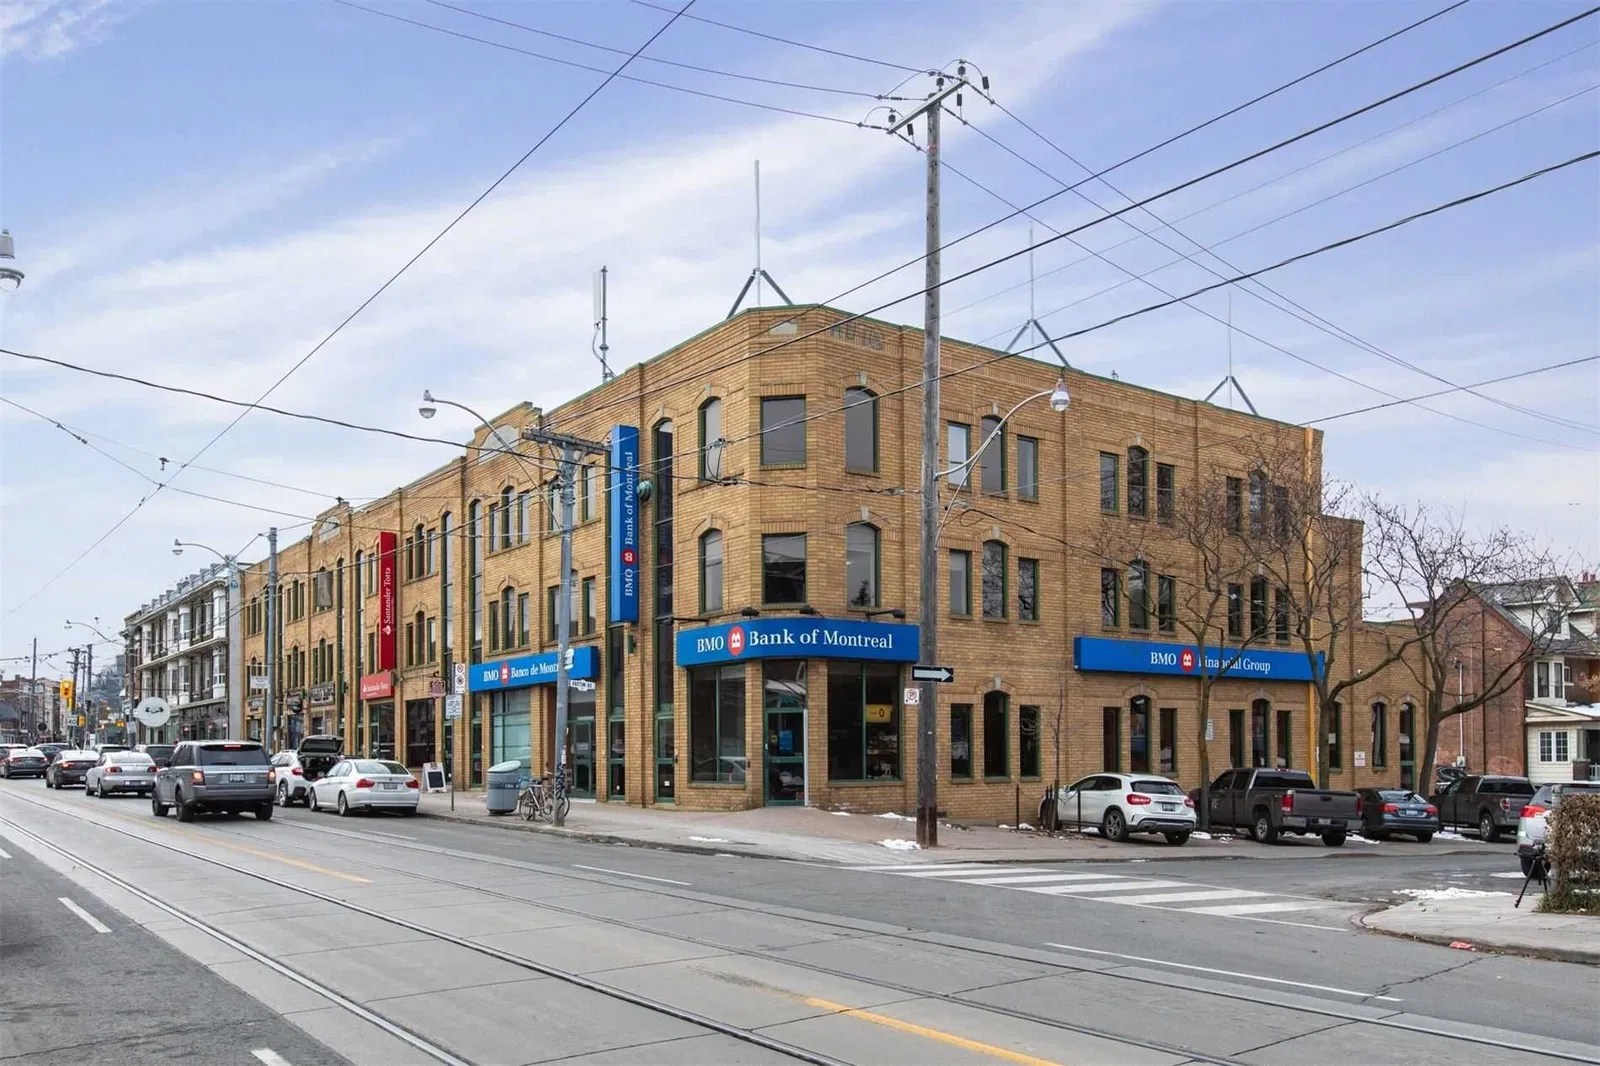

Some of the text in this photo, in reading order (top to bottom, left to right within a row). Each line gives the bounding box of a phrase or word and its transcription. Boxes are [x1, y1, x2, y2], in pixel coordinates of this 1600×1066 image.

[624, 451, 633, 597] BMO Bank of Monteal
[383, 567, 391, 624] Santander Totta
[697, 629, 893, 652] BMO Bank of Montreal
[483, 662, 559, 682] BMO Banco de Mont
[1150, 652, 1177, 665] BMO
[1243, 658, 1271, 674] Group
